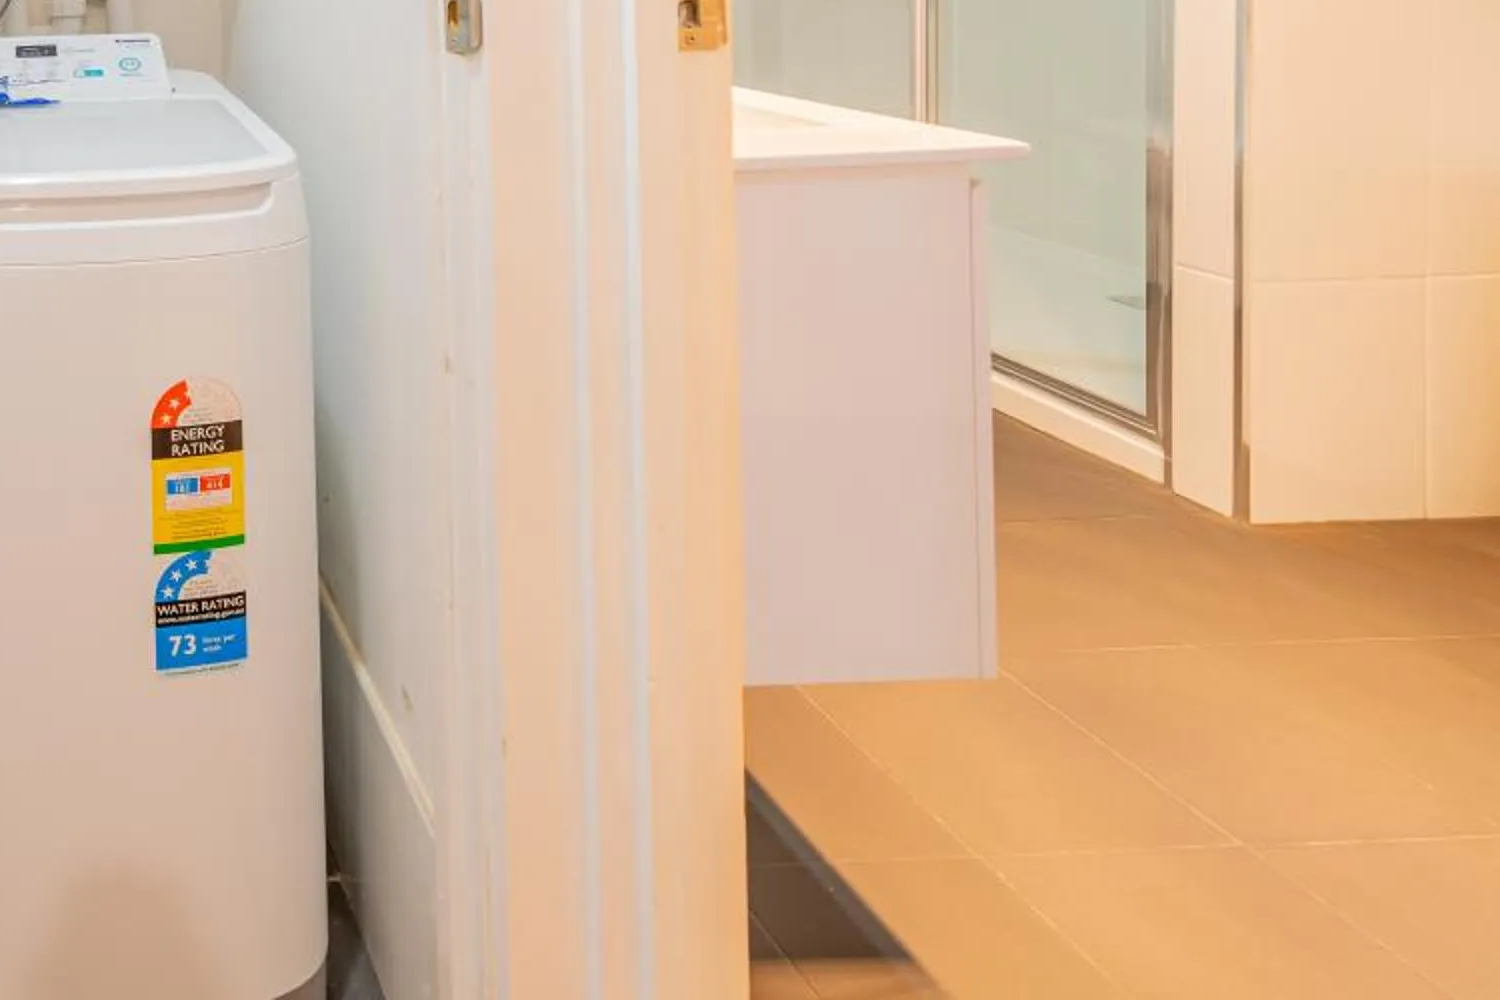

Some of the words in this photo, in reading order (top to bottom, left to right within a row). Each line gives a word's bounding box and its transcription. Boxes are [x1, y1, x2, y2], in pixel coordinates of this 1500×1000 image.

[171, 425, 225, 442] ENERGY
[171, 440, 225, 457] RATING
[157, 602, 199, 617] WATER
[201, 595, 245, 612] RATING
[169, 633, 197, 657] 73
